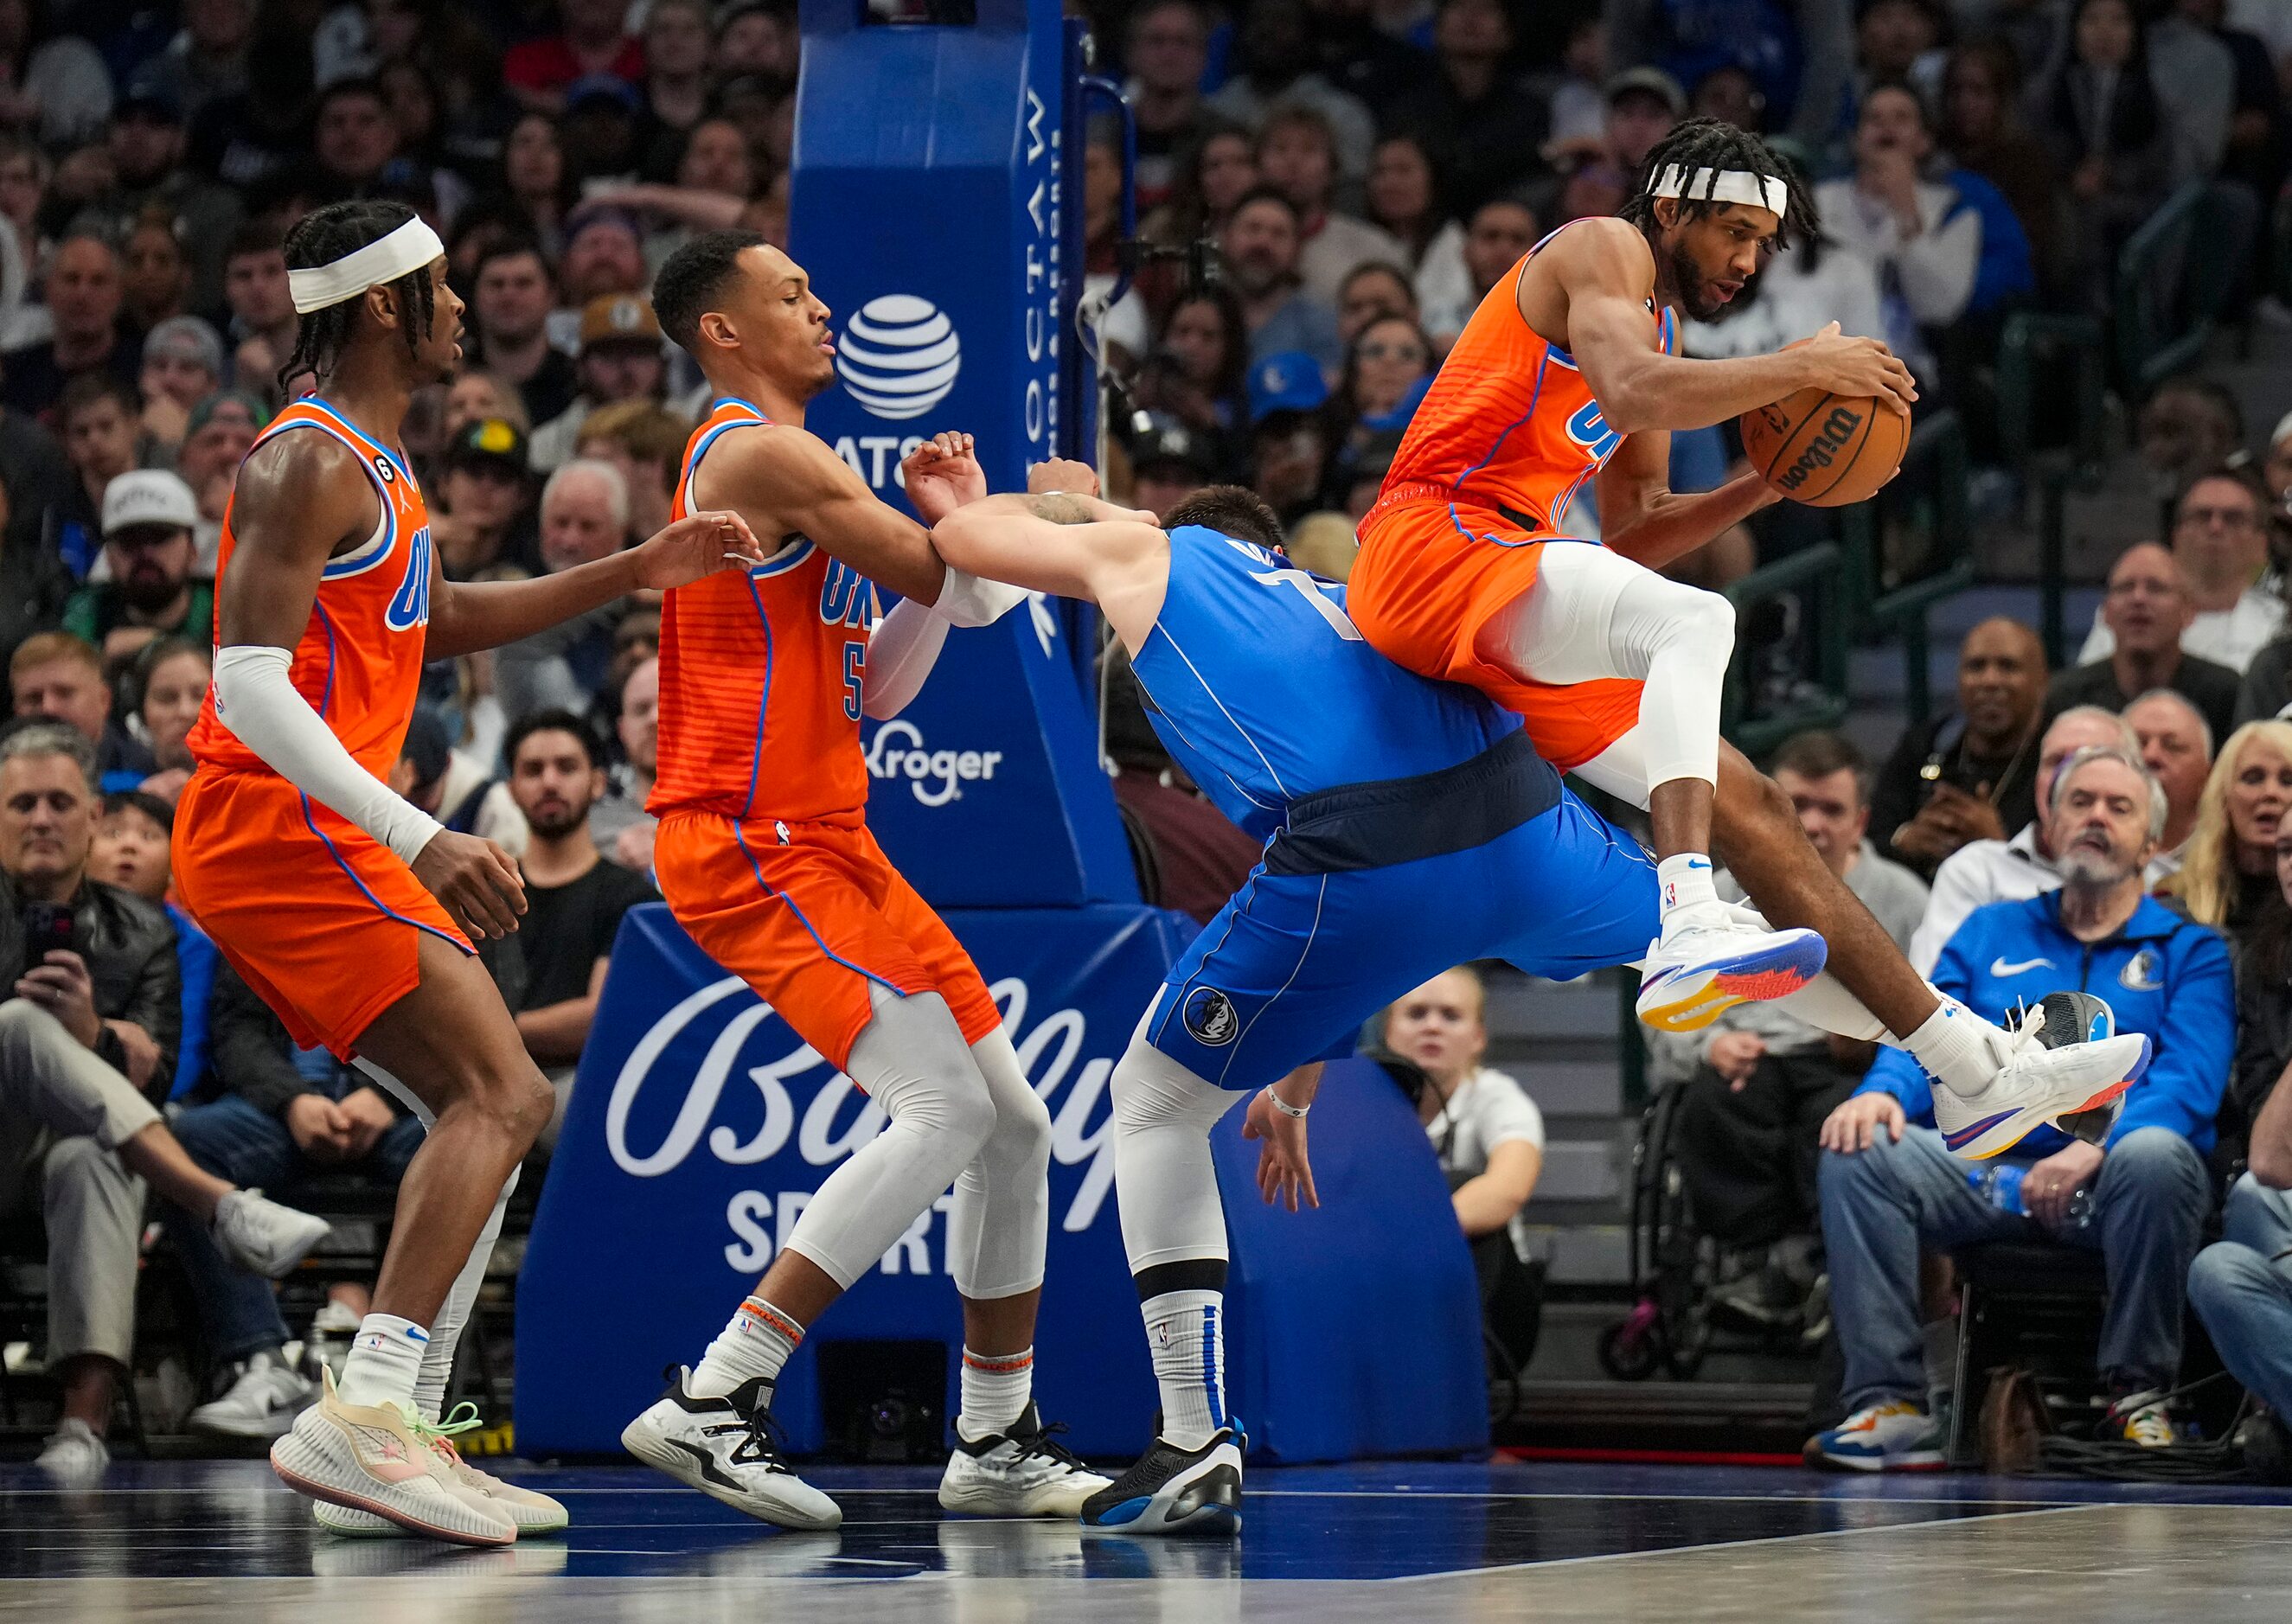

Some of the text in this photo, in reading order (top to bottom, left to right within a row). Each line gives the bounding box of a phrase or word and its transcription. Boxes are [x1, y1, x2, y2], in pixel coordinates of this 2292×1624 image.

[1025, 86, 1046, 481] OCTAW
[375, 457, 394, 482] 6
[1777, 407, 1863, 491] Wilson
[1247, 568, 1365, 641] 7
[843, 640, 866, 722] 5
